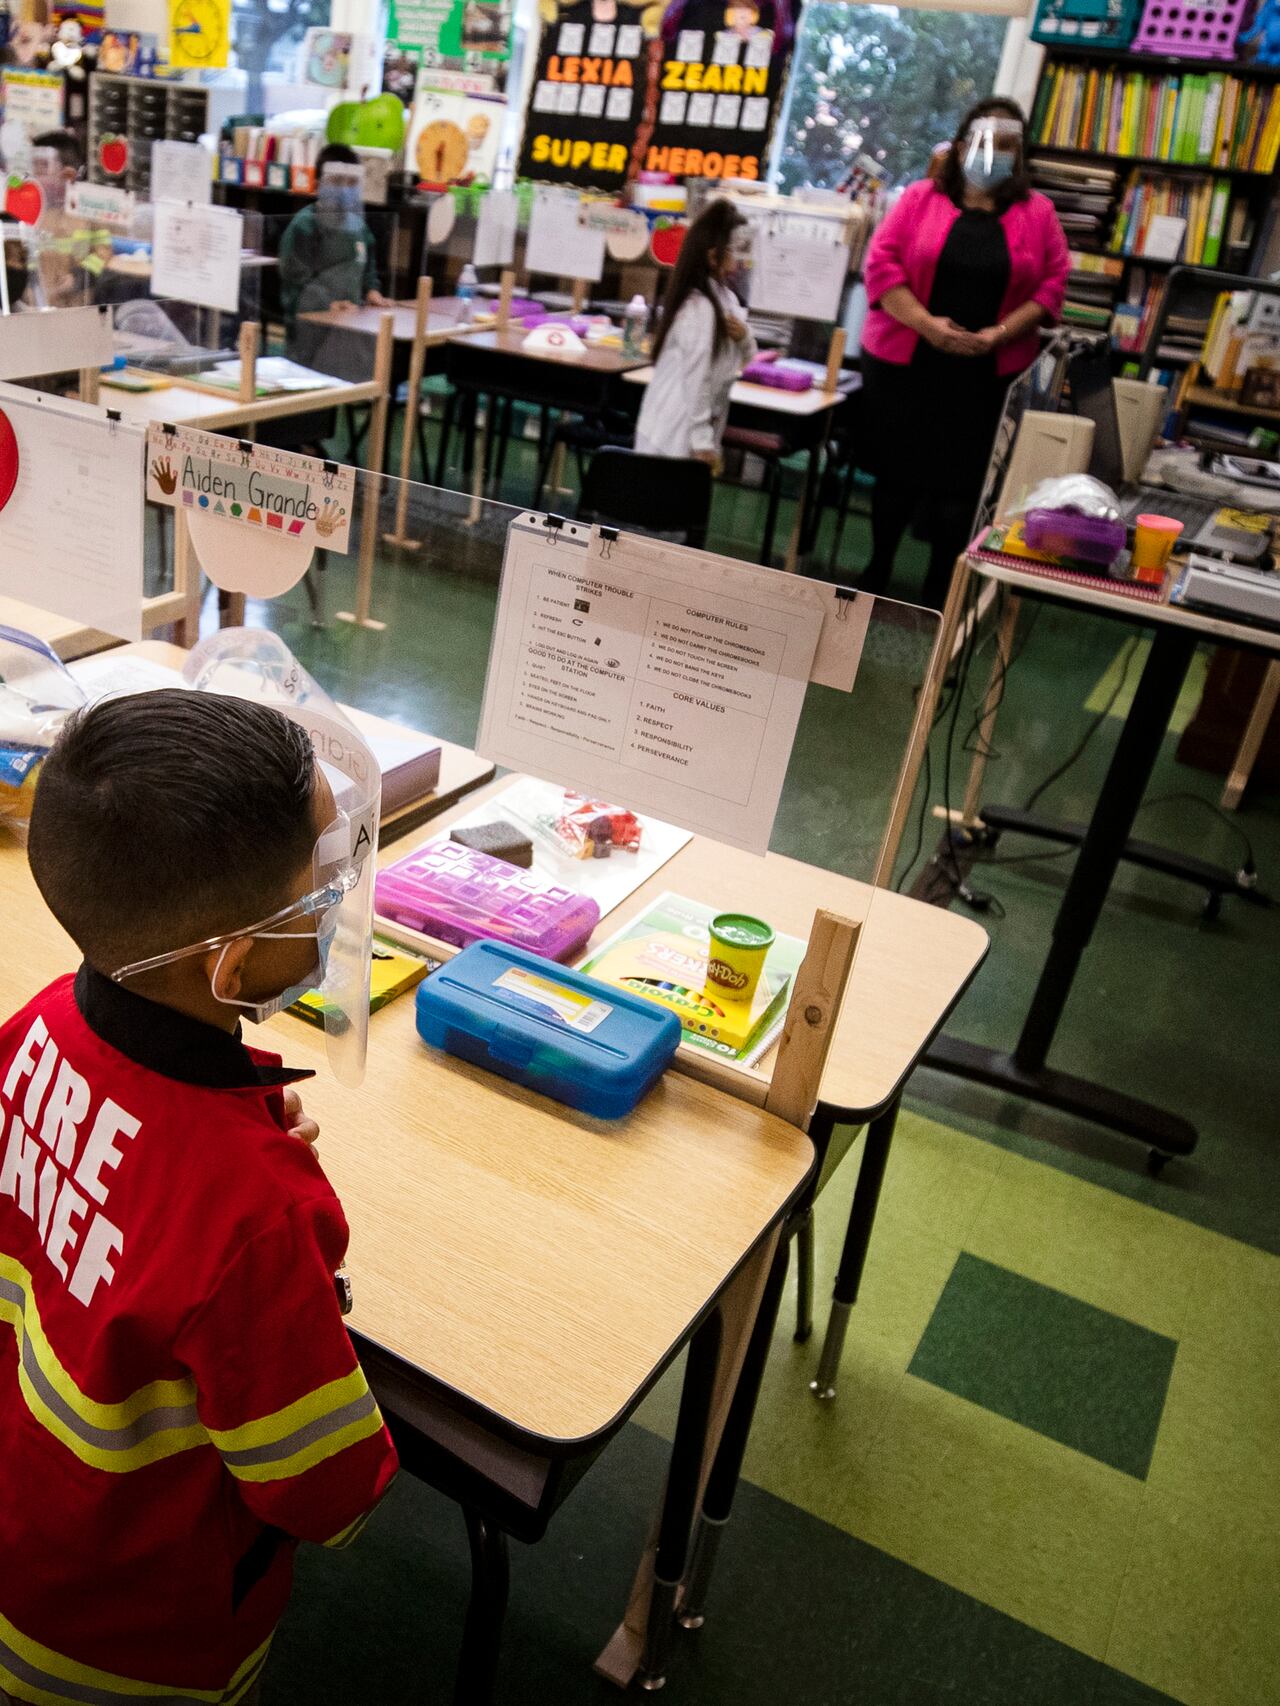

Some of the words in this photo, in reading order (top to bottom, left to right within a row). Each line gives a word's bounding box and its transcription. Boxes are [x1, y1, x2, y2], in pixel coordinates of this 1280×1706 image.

[546, 55, 634, 87] LEXIA
[660, 60, 769, 94] ZEARN
[531, 134, 628, 173] SUPER
[646, 145, 759, 180] HEROES
[182, 455, 236, 501] Aiden
[248, 471, 318, 521] Grande
[548, 570, 567, 579] WHEN
[567, 575, 604, 590] COMPUTER
[604, 585, 634, 598] TROUBLE
[576, 585, 603, 597] STRIKES
[686, 609, 723, 624] COMPUTER
[726, 620, 749, 632] RULES
[567, 634, 587, 644] BUTTON
[680, 627, 691, 635] NOT
[724, 640, 766, 656] CHROMEBOOKS
[528, 648, 547, 658] GOOD
[577, 663, 588, 671] THE
[590, 667, 626, 682] COMPUTER
[687, 653, 706, 662] TOUCH
[717, 662, 738, 672] SCREEN
[689, 642, 707, 651] CARRY
[718, 651, 760, 667] CHROMEBOOKS
[561, 665, 588, 678] STATION
[685, 664, 700, 672] BANG
[711, 672, 725, 680] KEYS
[682, 675, 699, 684] CLOSE
[711, 684, 752, 700] CHROMEBOOKS
[646, 703, 666, 714] FAITH
[673, 692, 695, 704] CORE
[695, 699, 726, 714] VALUES
[643, 717, 674, 732] RESPECT
[640, 731, 694, 753] RESPONSIBILITY
[637, 745, 689, 767] PERSEVERANCE
[626, 978, 715, 1018] Crayola
[2, 1014, 143, 1207] FIRE
